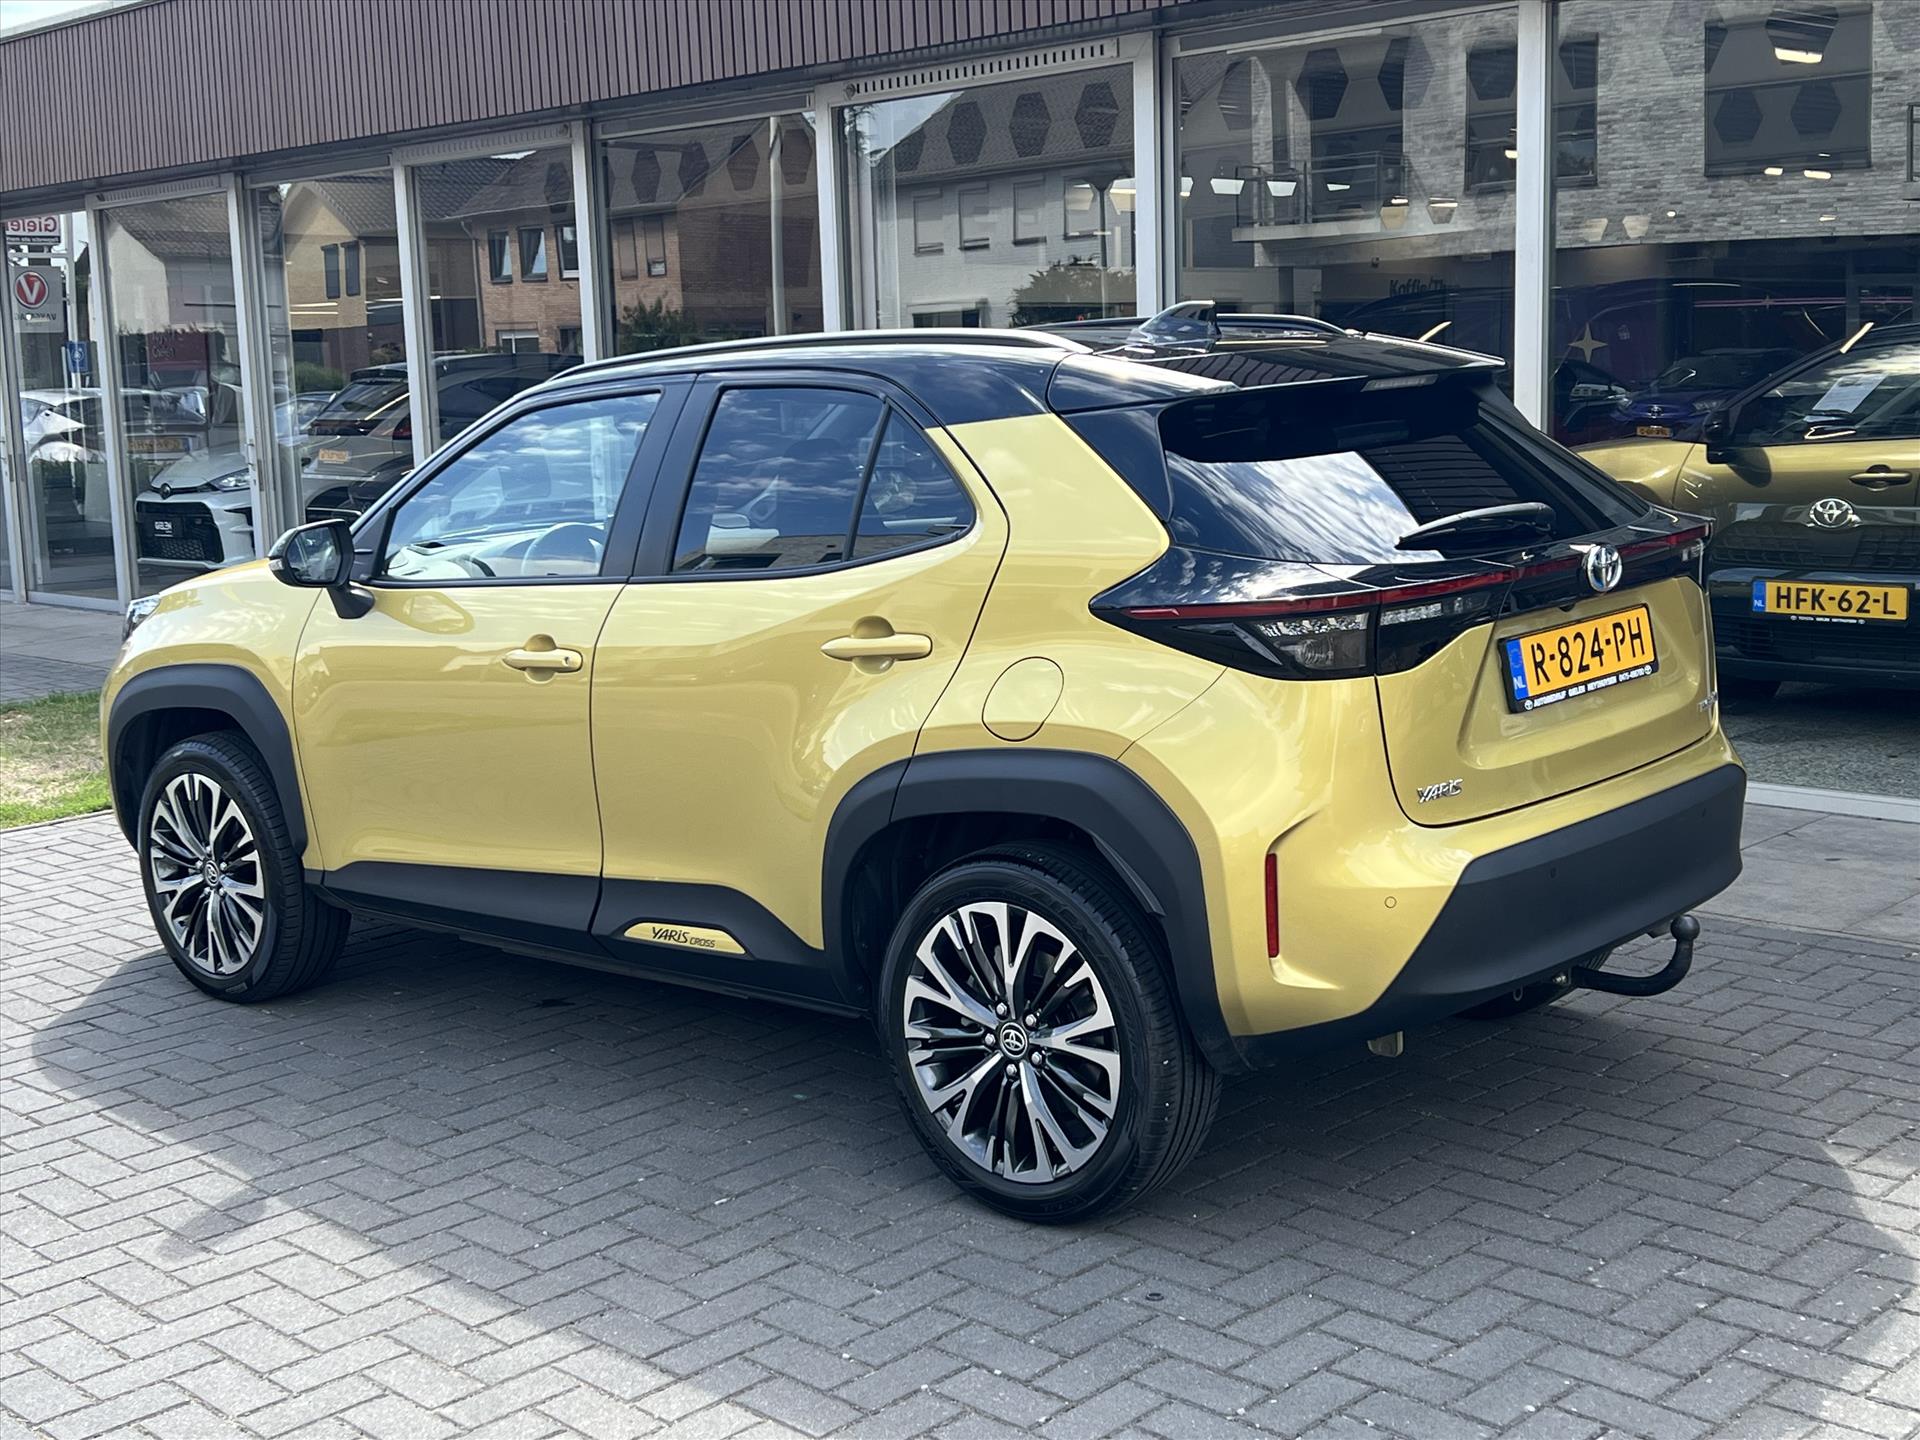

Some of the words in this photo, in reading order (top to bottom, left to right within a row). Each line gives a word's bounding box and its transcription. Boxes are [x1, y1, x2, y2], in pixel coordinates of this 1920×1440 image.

[1776, 585, 1897, 615] HFK-62-L
[1530, 616, 1645, 686] R-824-PH
[1513, 675, 1526, 690] NL
[652, 926, 690, 944] YARIS
[690, 936, 716, 948] CROSS
